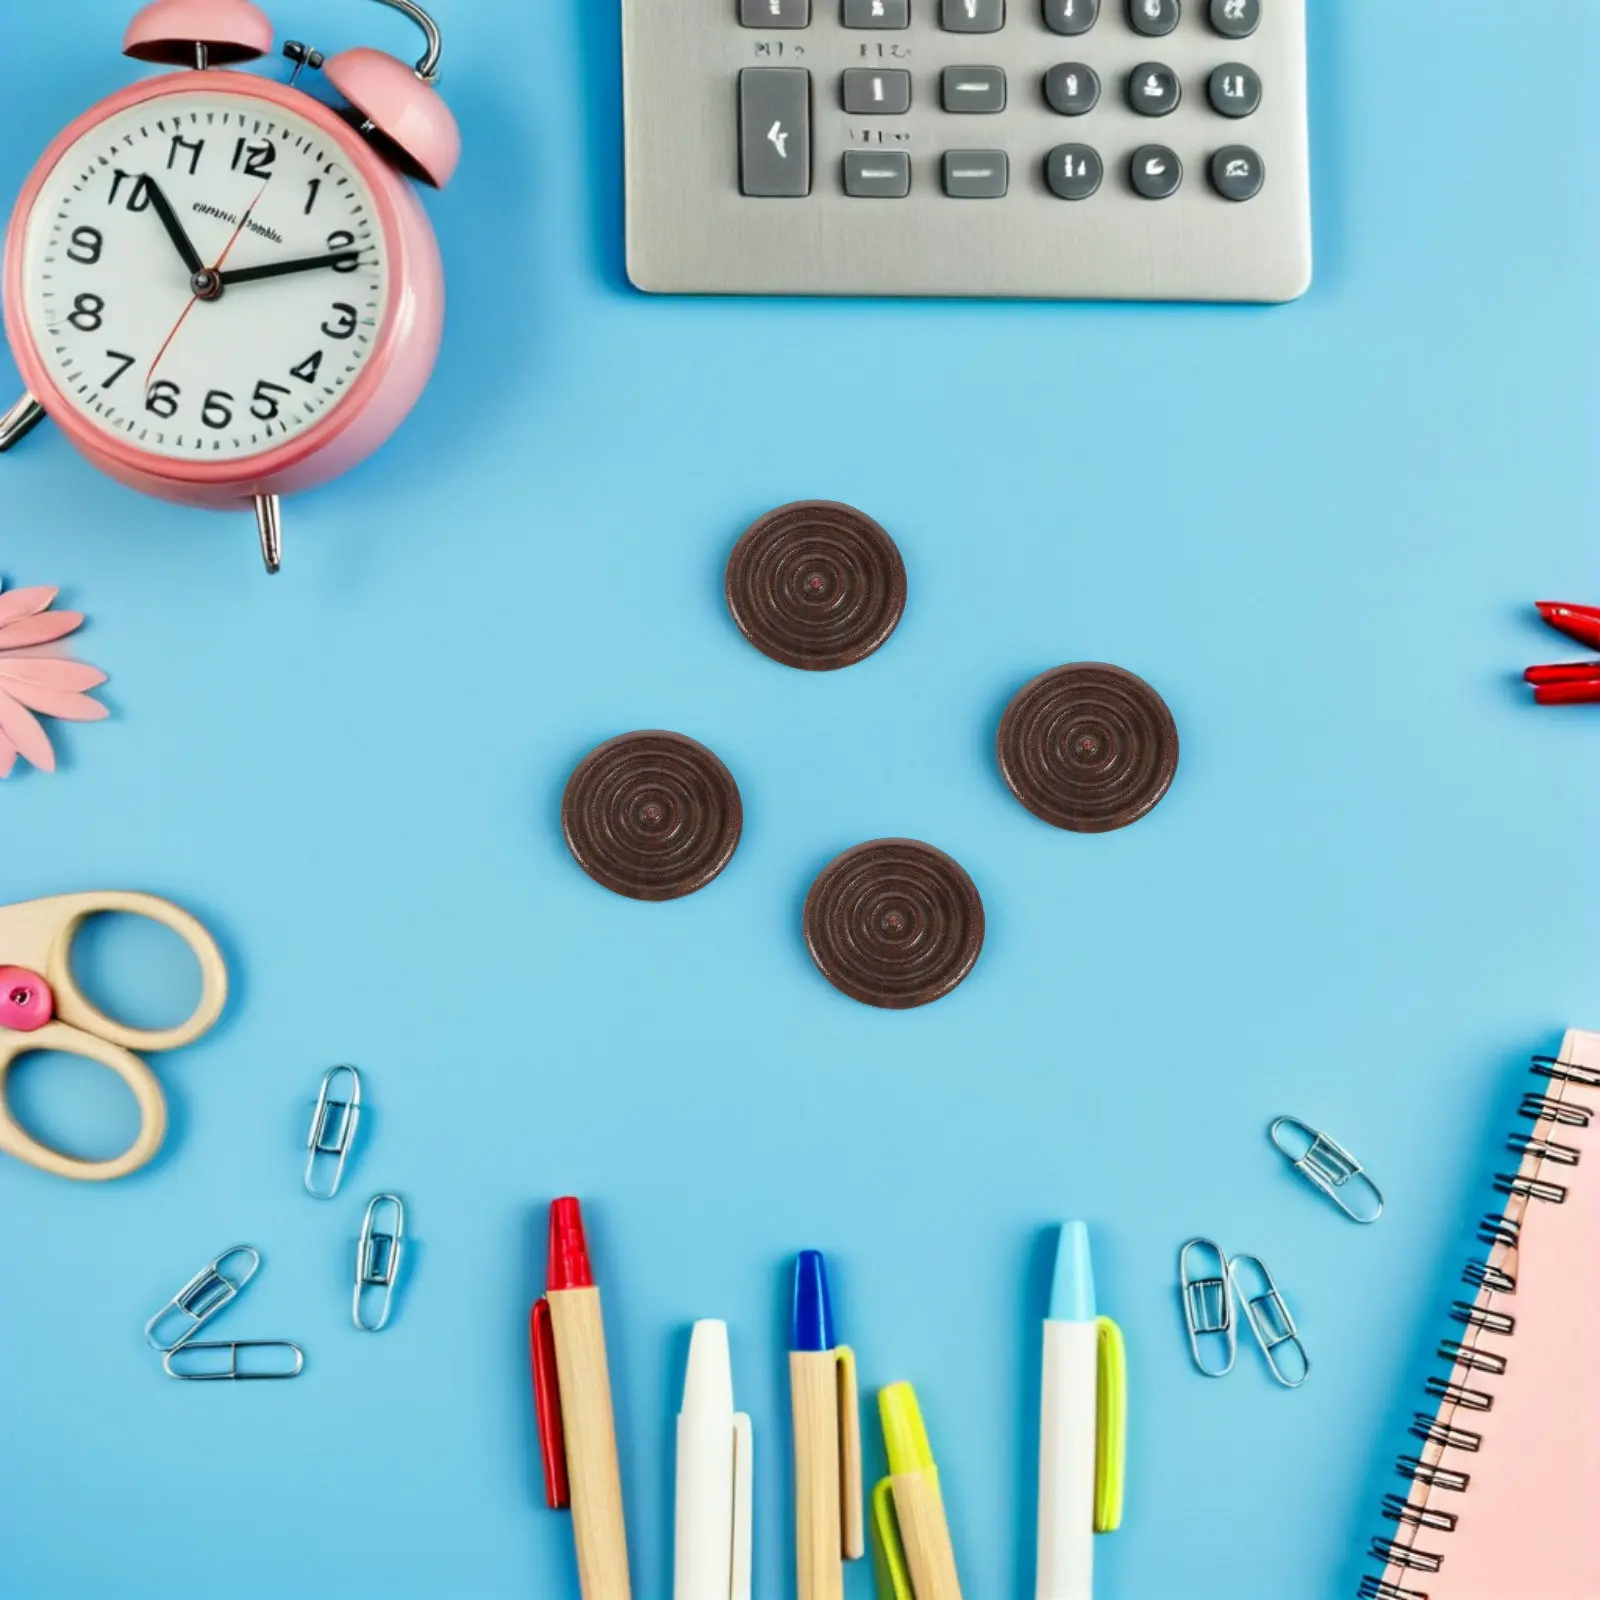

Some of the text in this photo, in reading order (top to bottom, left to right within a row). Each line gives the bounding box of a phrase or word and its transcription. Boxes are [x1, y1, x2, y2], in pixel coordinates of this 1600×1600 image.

[231, 136, 276, 180] 12
[303, 178, 321, 215] 1
[67, 226, 103, 264] 9
[67, 293, 104, 331] 8
[321, 303, 357, 339] 3
[102, 350, 135, 389] 7
[290, 350, 323, 384] 4
[249, 380, 291, 421] 5
